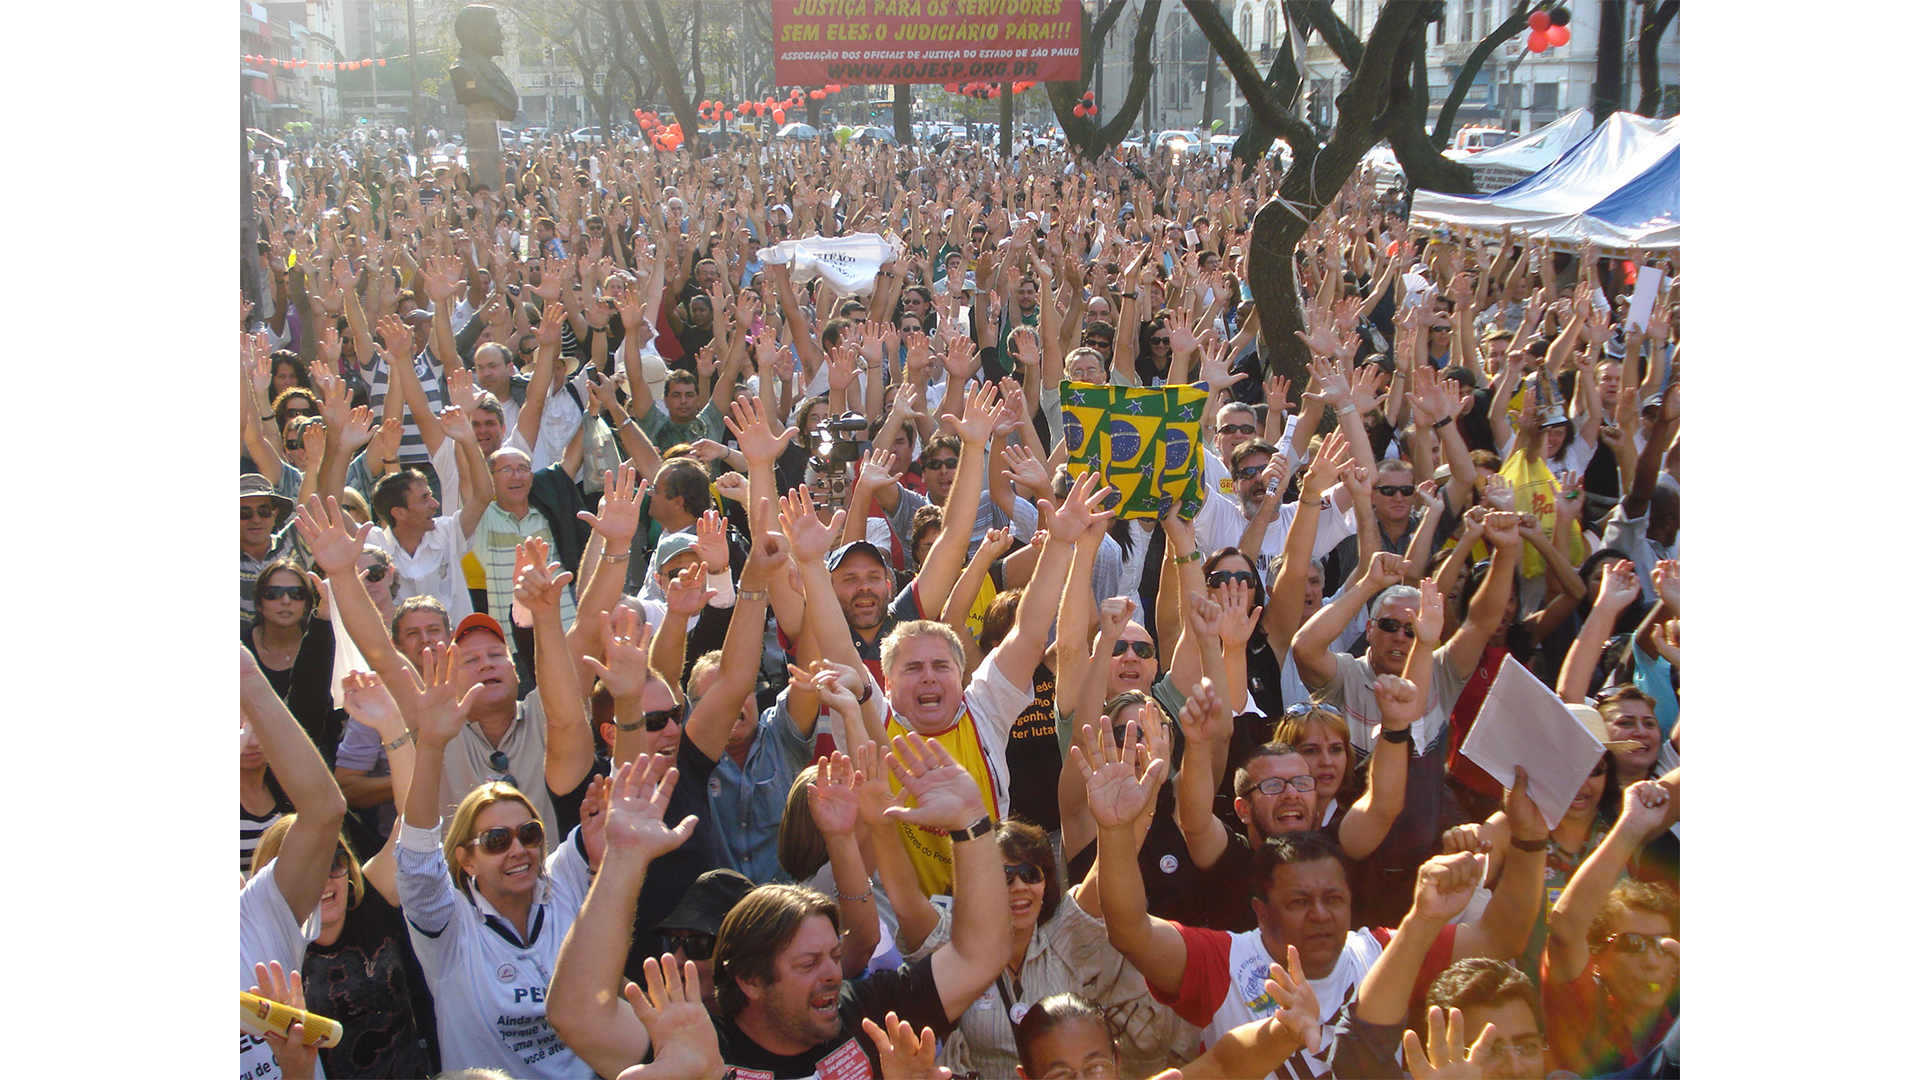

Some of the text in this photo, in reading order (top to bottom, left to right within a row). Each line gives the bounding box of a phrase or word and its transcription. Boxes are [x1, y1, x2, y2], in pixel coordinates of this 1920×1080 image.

[793, 0, 1062, 19] JUSTIÇA PARA OS SERVIDORES
[780, 24, 820, 42] SEM
[893, 19, 999, 42] JUDICIÁRIO
[1005, 19, 1072, 41] PÁRA!!!
[780, 47, 1080, 61] ASSOCIAÇÃO DOS OFICIAIS DE JUSTIÇA DO ESTADO DE SÃO PAULO
[827, 61, 1039, 79] WWW.AOJESP.ORG.BR
[1012, 730, 1029, 739] ter
[921, 847, 932, 857] do
[497, 1015, 531, 1026] Ainda
[524, 1048, 546, 1065] você
[255, 1062, 272, 1077] de
